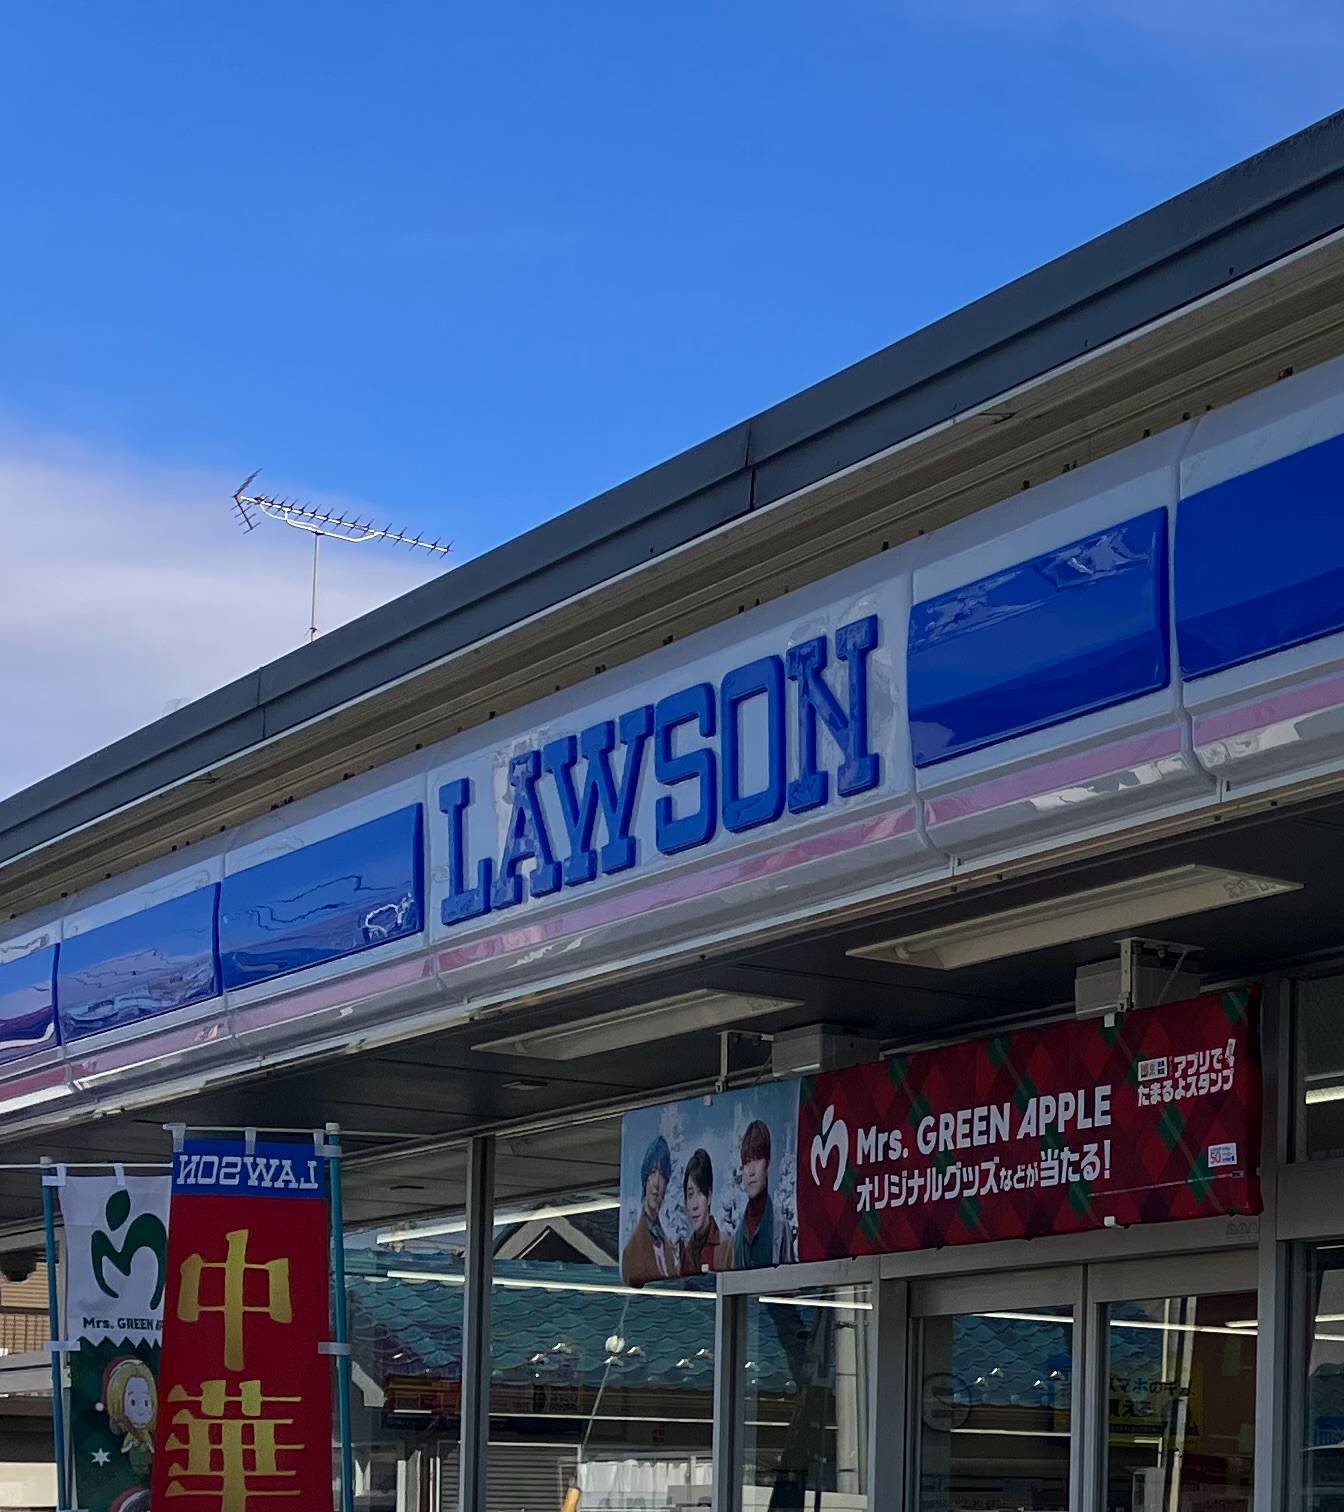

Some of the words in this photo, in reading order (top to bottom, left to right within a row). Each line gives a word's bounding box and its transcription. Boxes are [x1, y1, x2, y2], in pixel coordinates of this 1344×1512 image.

[439, 614, 880, 926] LAWSON
[1174, 1048, 1223, 1078] アプリで
[1138, 1067, 1234, 1107] たまるよスタンプ
[856, 1125, 909, 1165] Mrs.
[917, 1102, 1011, 1155] GREEN
[1016, 1084, 1112, 1140] APPLE
[83, 1317, 114, 1330] Mrs.
[118, 1318, 153, 1330] GREEN
